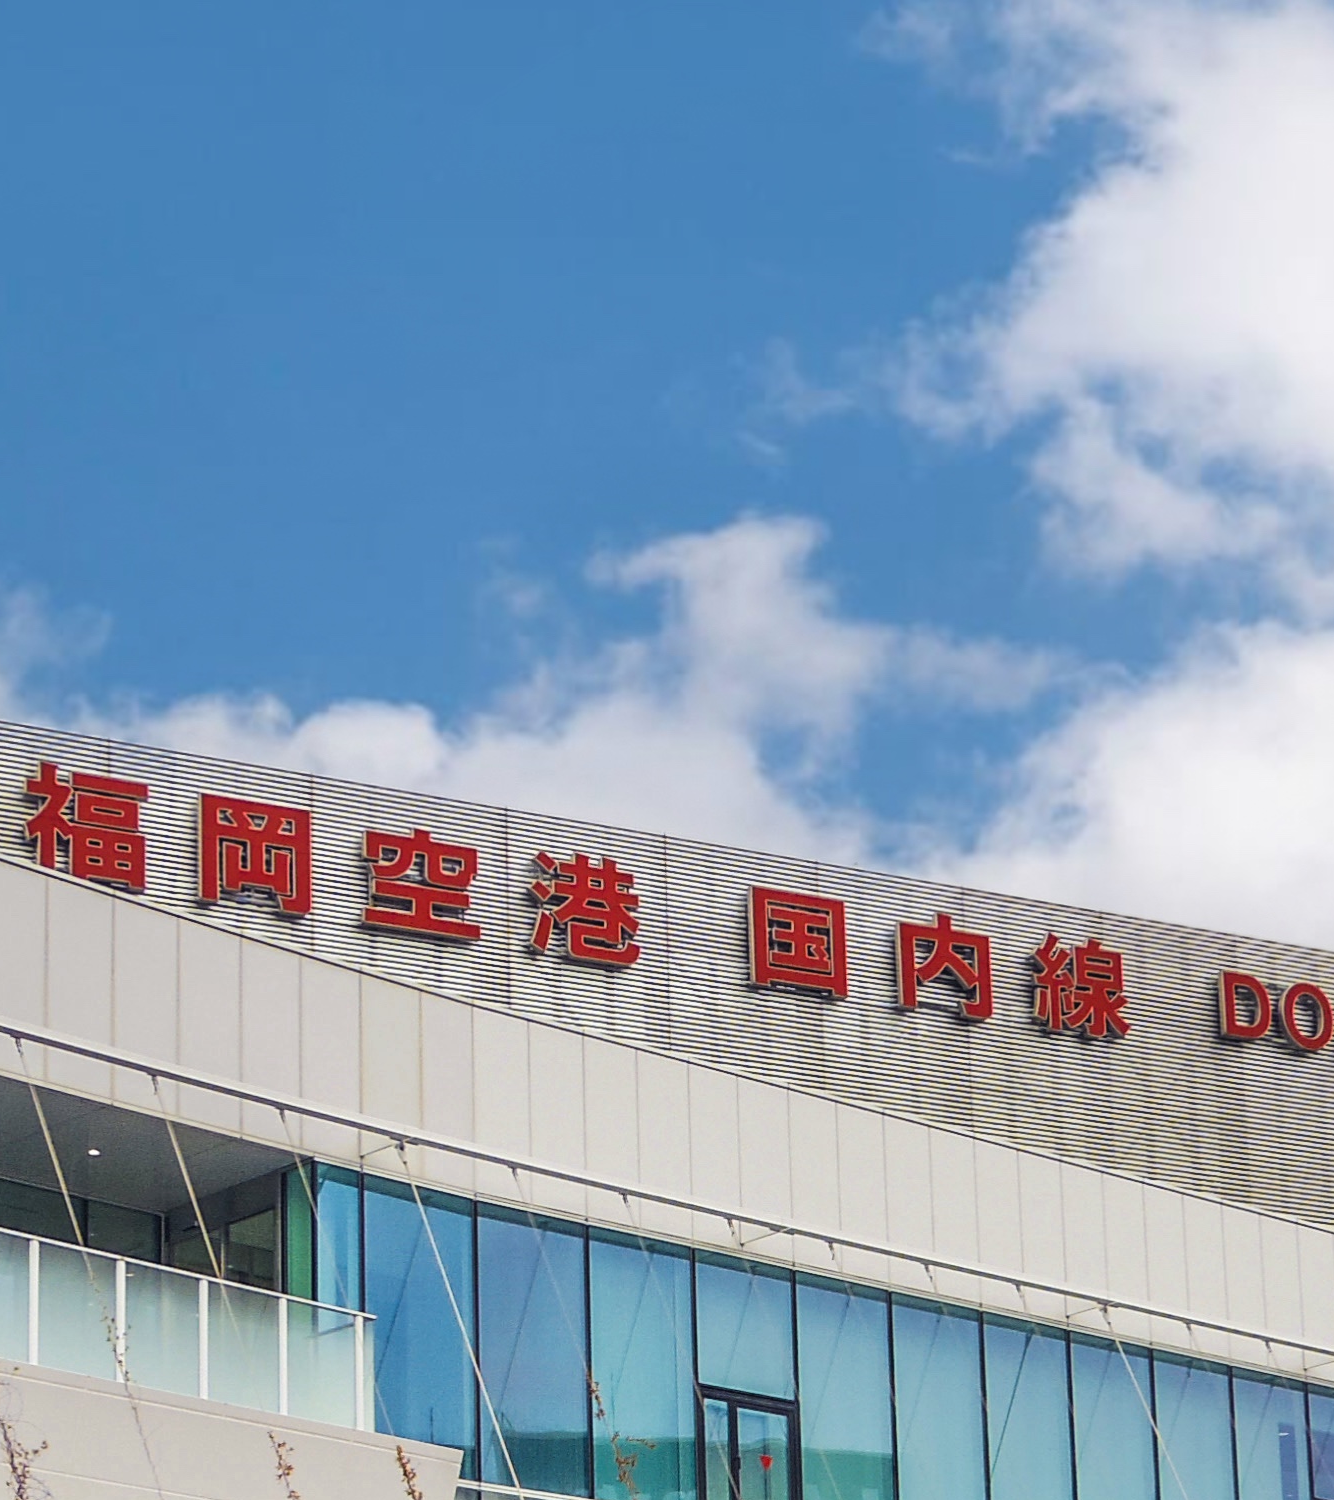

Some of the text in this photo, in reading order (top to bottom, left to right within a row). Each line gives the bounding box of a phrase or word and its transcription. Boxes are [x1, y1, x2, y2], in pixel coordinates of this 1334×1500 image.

[24, 760, 1132, 1039] 福岡空港 国内線
